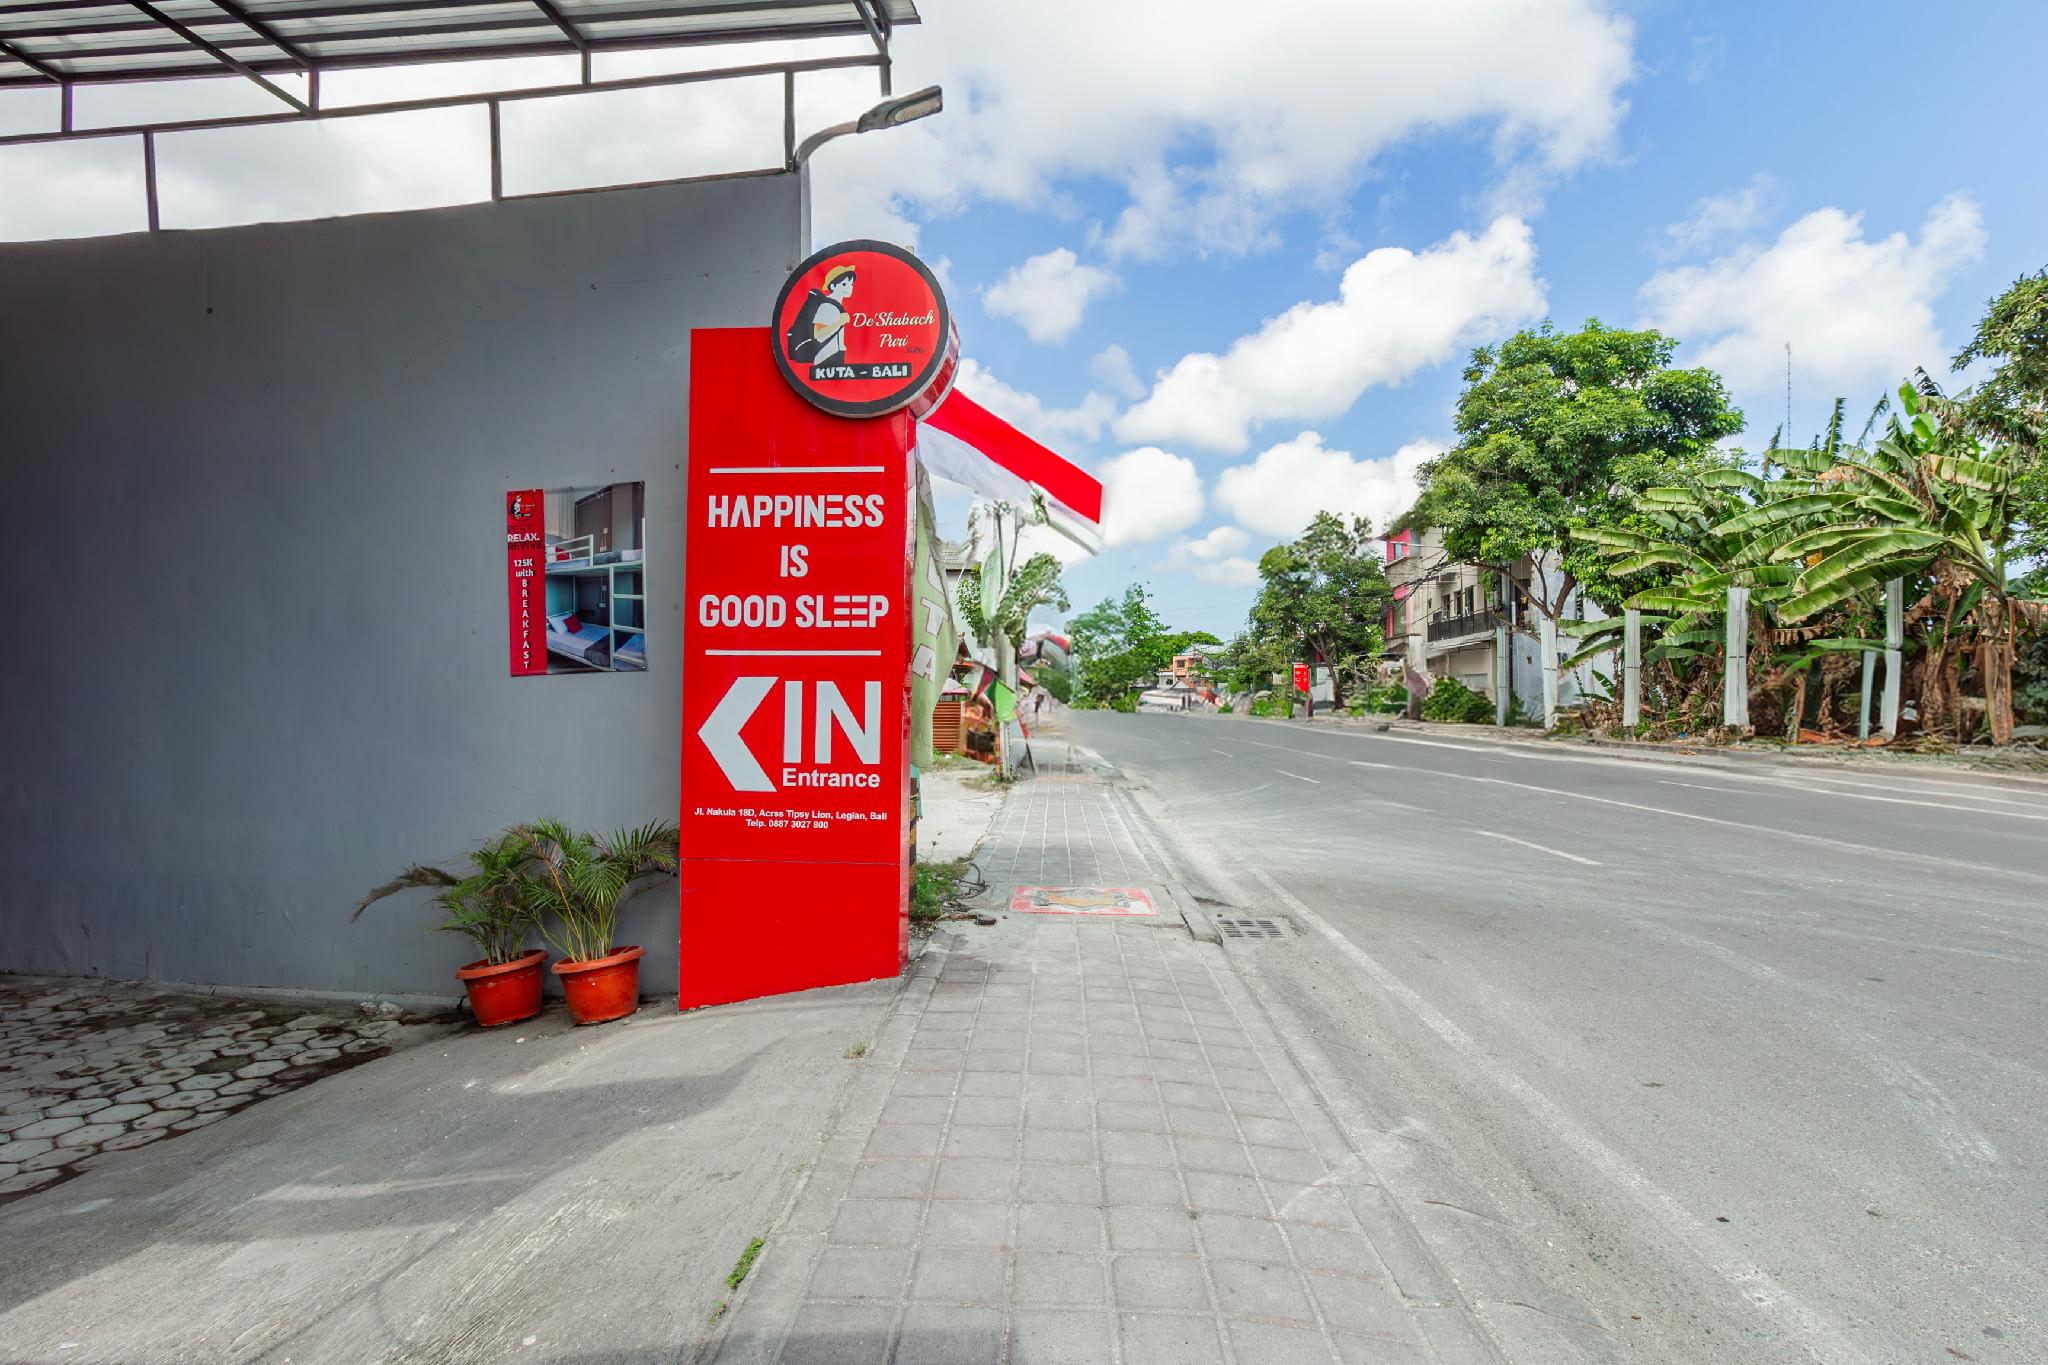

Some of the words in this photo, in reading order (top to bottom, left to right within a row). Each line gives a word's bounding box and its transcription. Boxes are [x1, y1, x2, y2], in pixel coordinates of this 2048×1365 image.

[879, 334, 908, 348] Puri
[815, 367, 855, 379] KUTA
[872, 365, 908, 378] BALI
[707, 494, 884, 528] HAPPINESS
[507, 533, 541, 543] RELAX.
[513, 559, 533, 567] 125K
[780, 545, 809, 577] IS
[515, 569, 534, 577] with
[699, 594, 786, 628] GOOD
[795, 594, 889, 628] SLEEP
[522, 579, 530, 669] BREAKFAST
[783, 680, 881, 765] IN
[782, 768, 880, 788] Entrance
[706, 808, 736, 817] Nakula
[786, 809, 809, 819] Tipsy
[811, 809, 834, 820] Lion,
[835, 811, 868, 822] Legian,
[870, 811, 888, 821] Bali
[745, 818, 766, 829] Telp.
[768, 819, 788, 828] 0887
[791, 820, 811, 829] 3027
